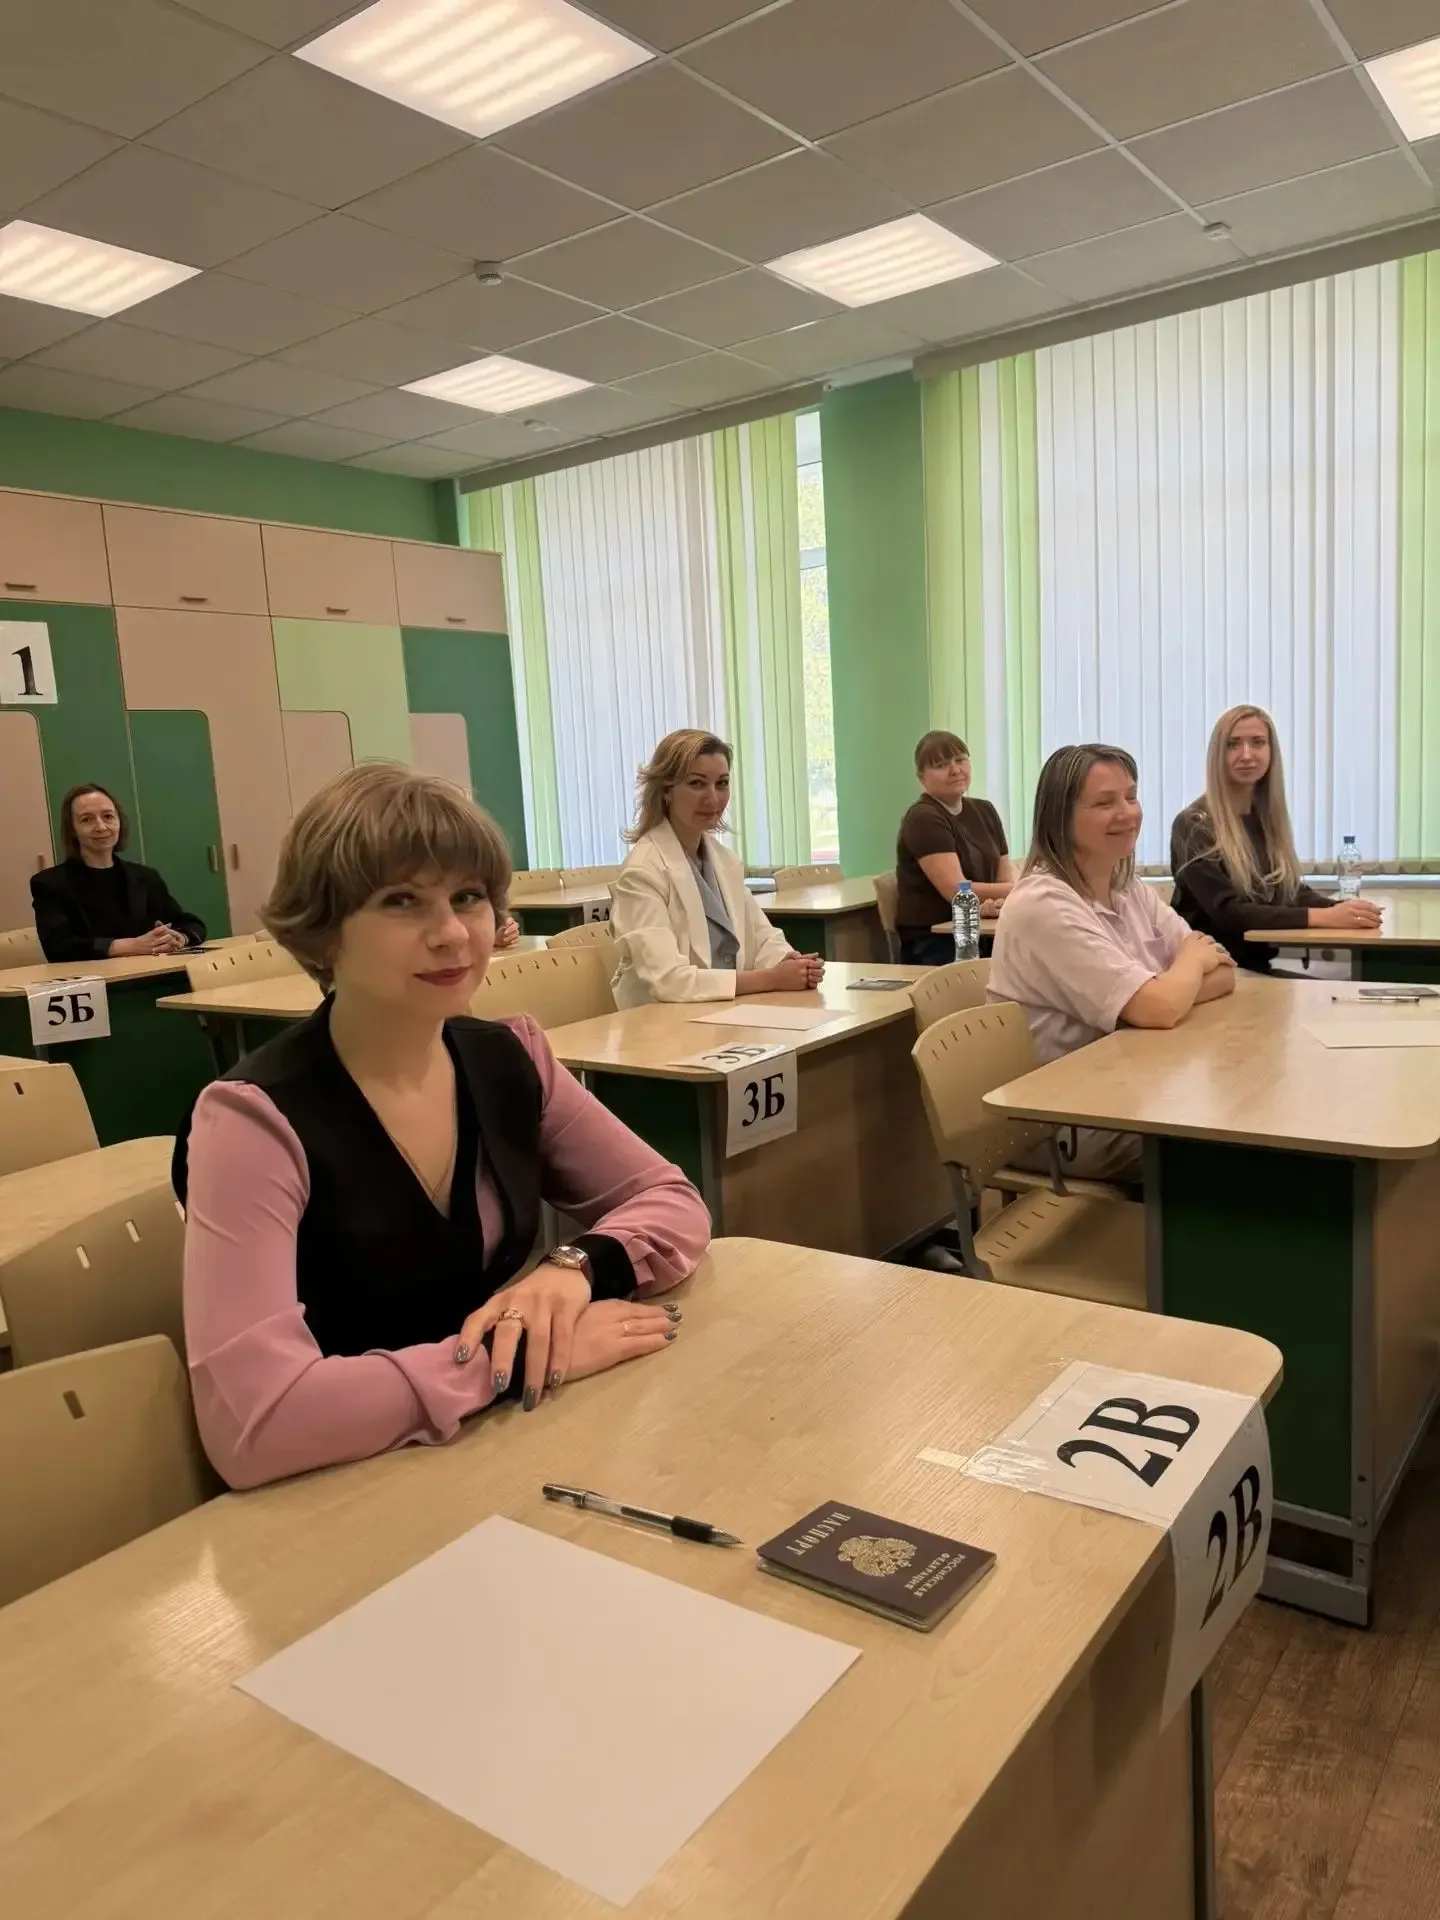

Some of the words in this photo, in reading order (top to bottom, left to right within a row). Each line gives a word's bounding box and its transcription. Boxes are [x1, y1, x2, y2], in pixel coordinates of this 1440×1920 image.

[12, 645, 44, 696] 1
[47, 992, 95, 1026] 5Б
[742, 1072, 785, 1127] 3Б
[1056, 1397, 1200, 1488] 2В
[786, 1512, 851, 1555] ПАСПОРТ
[1200, 1464, 1262, 1631] 2В
[904, 1551, 951, 1590] ФЕДЕРАЦИЯ
[914, 1553, 966, 1598] РОССИЙСКАЯ
